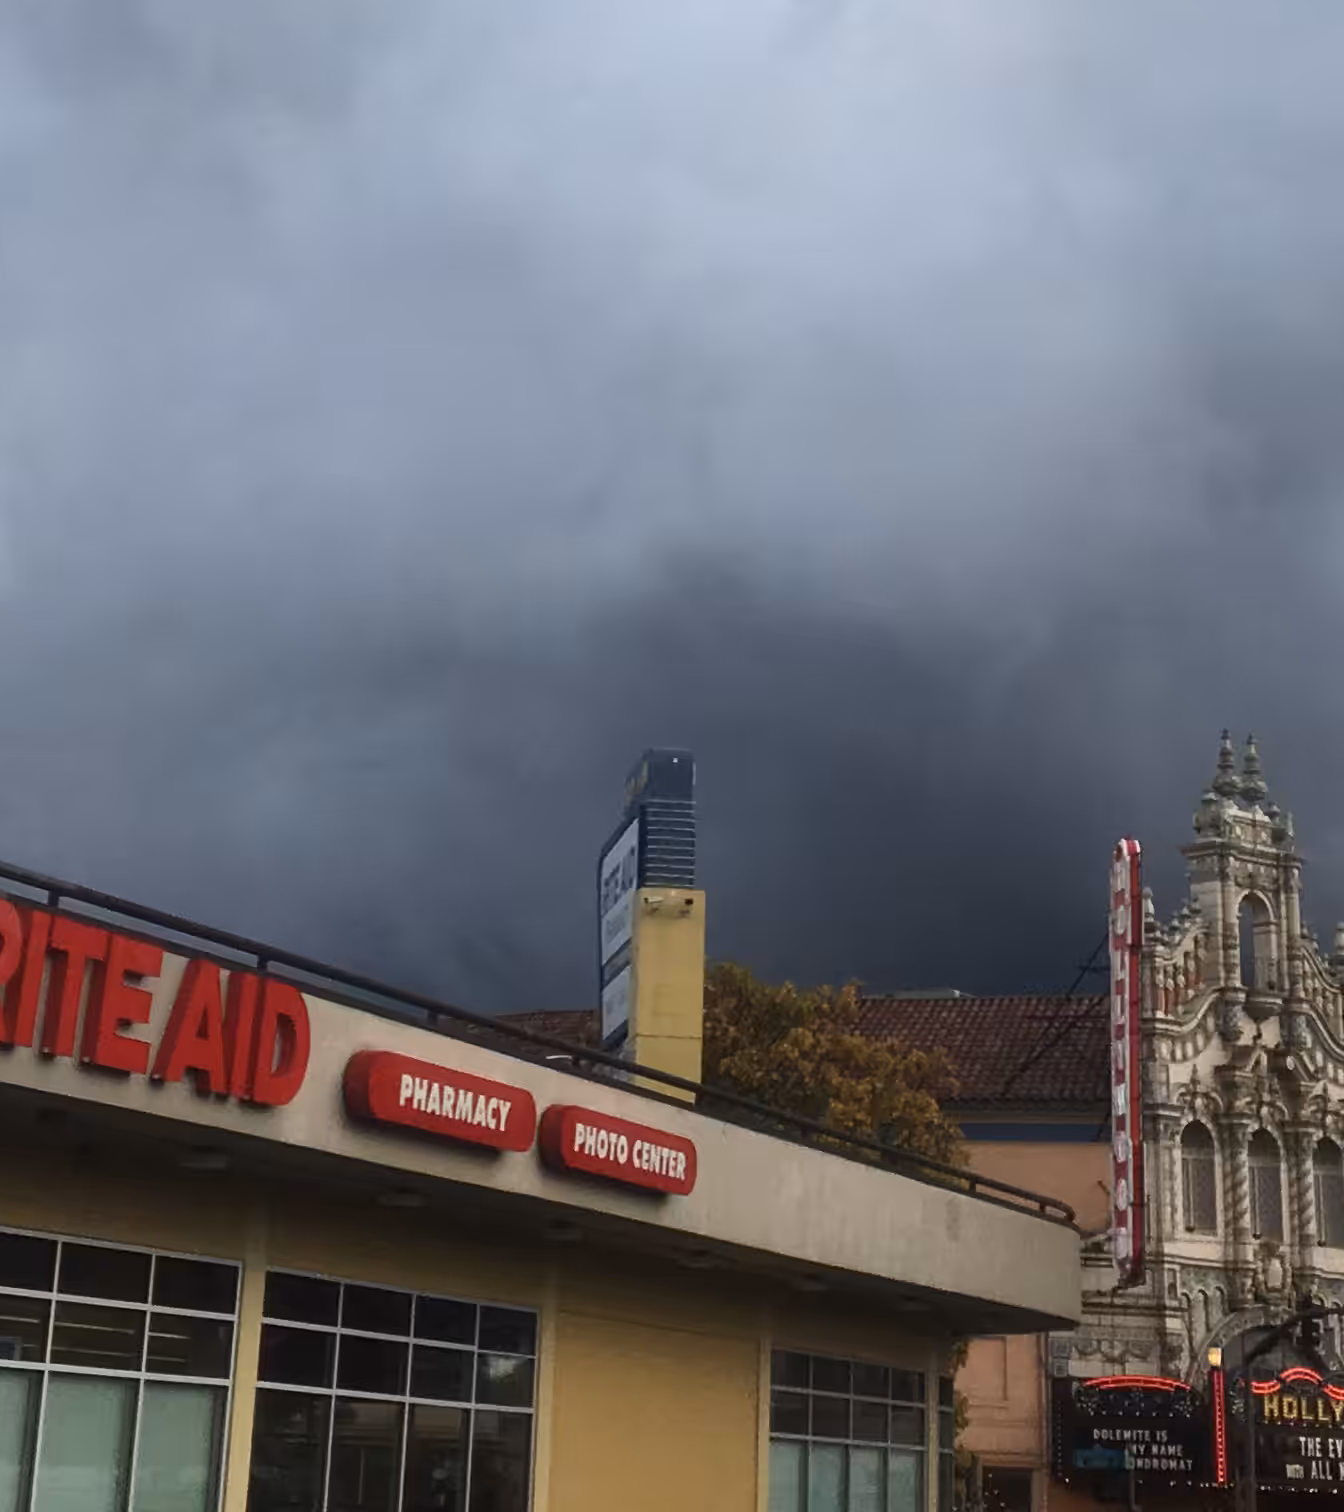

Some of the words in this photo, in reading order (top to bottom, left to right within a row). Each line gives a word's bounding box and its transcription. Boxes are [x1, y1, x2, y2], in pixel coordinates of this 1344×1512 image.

[156, 958, 311, 1107] AID
[399, 1073, 512, 1133] PHARMACY
[573, 1122, 629, 1165] PHOTO
[632, 1138, 687, 1181] CENTER
[1093, 1428, 1151, 1441] DOLEMITE
[1156, 1430, 1168, 1442] IS
[1152, 1444, 1184, 1457] NAME
[1299, 1437, 1323, 1458] THE
[1311, 1460, 1333, 1481] ALL
